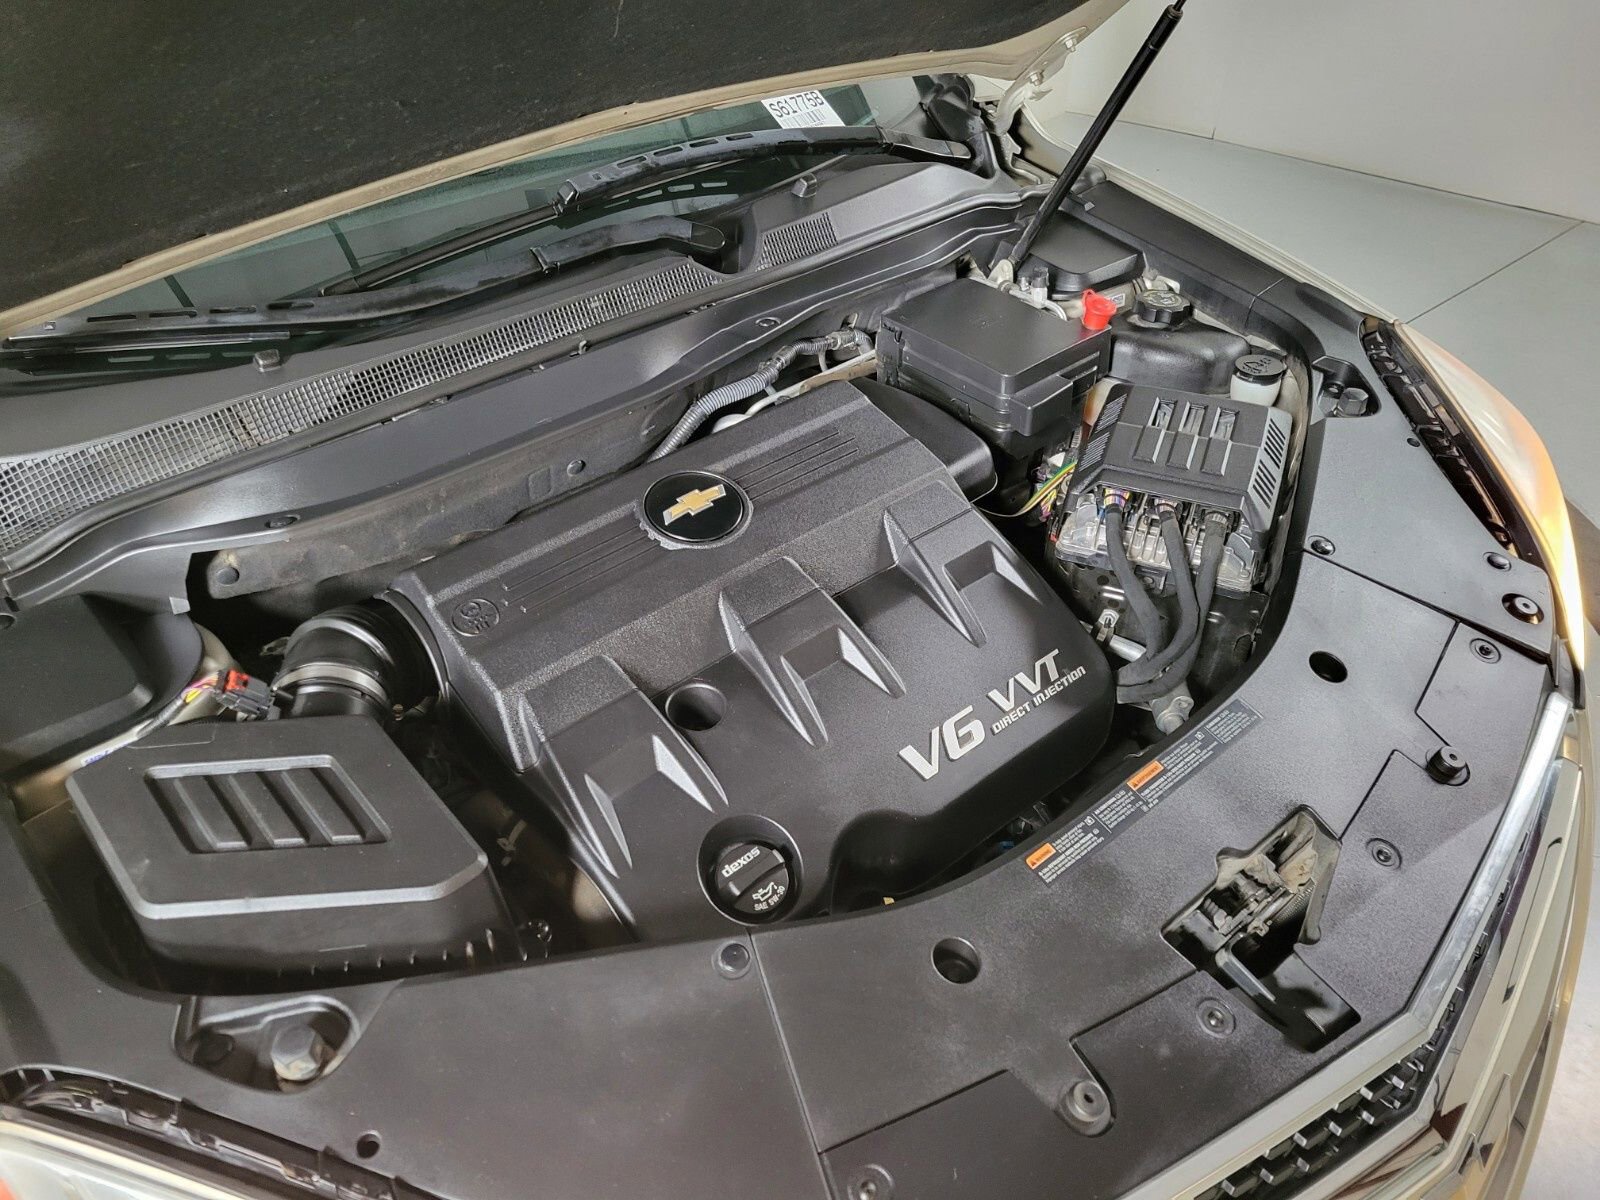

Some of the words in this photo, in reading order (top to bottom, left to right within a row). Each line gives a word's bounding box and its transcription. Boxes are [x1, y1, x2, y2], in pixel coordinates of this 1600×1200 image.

[769, 91, 824, 117] S61775B
[899, 705, 985, 780] V6
[988, 648, 1060, 712] VVT
[992, 702, 1032, 735] DIRECT
[1033, 665, 1087, 707] INJECTION
[721, 846, 760, 878] dexos
[754, 902, 769, 911] SAE
